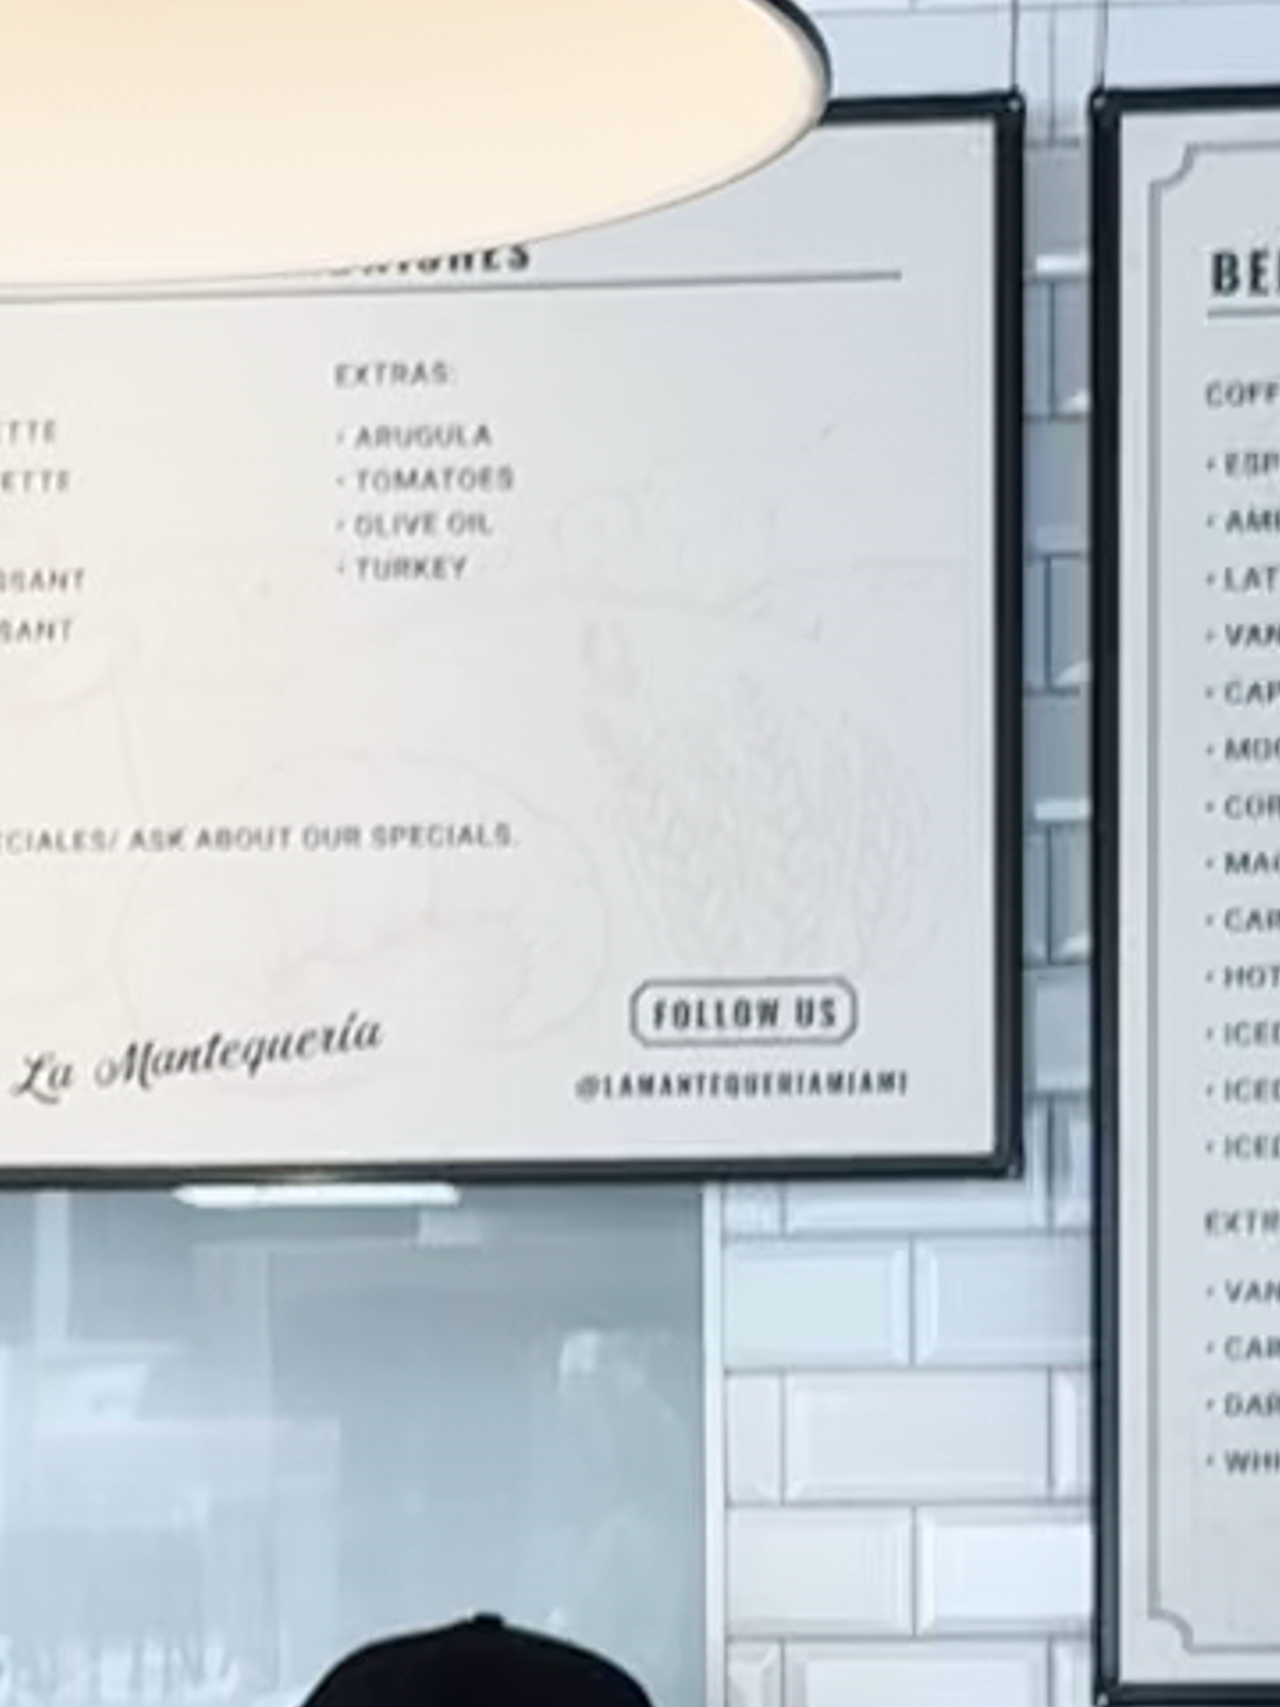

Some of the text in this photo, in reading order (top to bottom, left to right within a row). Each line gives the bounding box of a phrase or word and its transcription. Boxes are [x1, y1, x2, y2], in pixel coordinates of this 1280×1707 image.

[354, 422, 493, 449] ARUGULA
[356, 463, 515, 493] TOMATOES
[353, 509, 494, 540] OLIVE OIL
[356, 554, 468, 582] TURKEY
[129, 827, 185, 853] ASK
[194, 824, 292, 852] ABOUT
[301, 824, 363, 852] OUR
[652, 996, 837, 1031] FOLLOW US
[11, 1011, 384, 1105] La Mantequería
[575, 1069, 908, 1100] @LAMANTEQUERIAMIAMI
